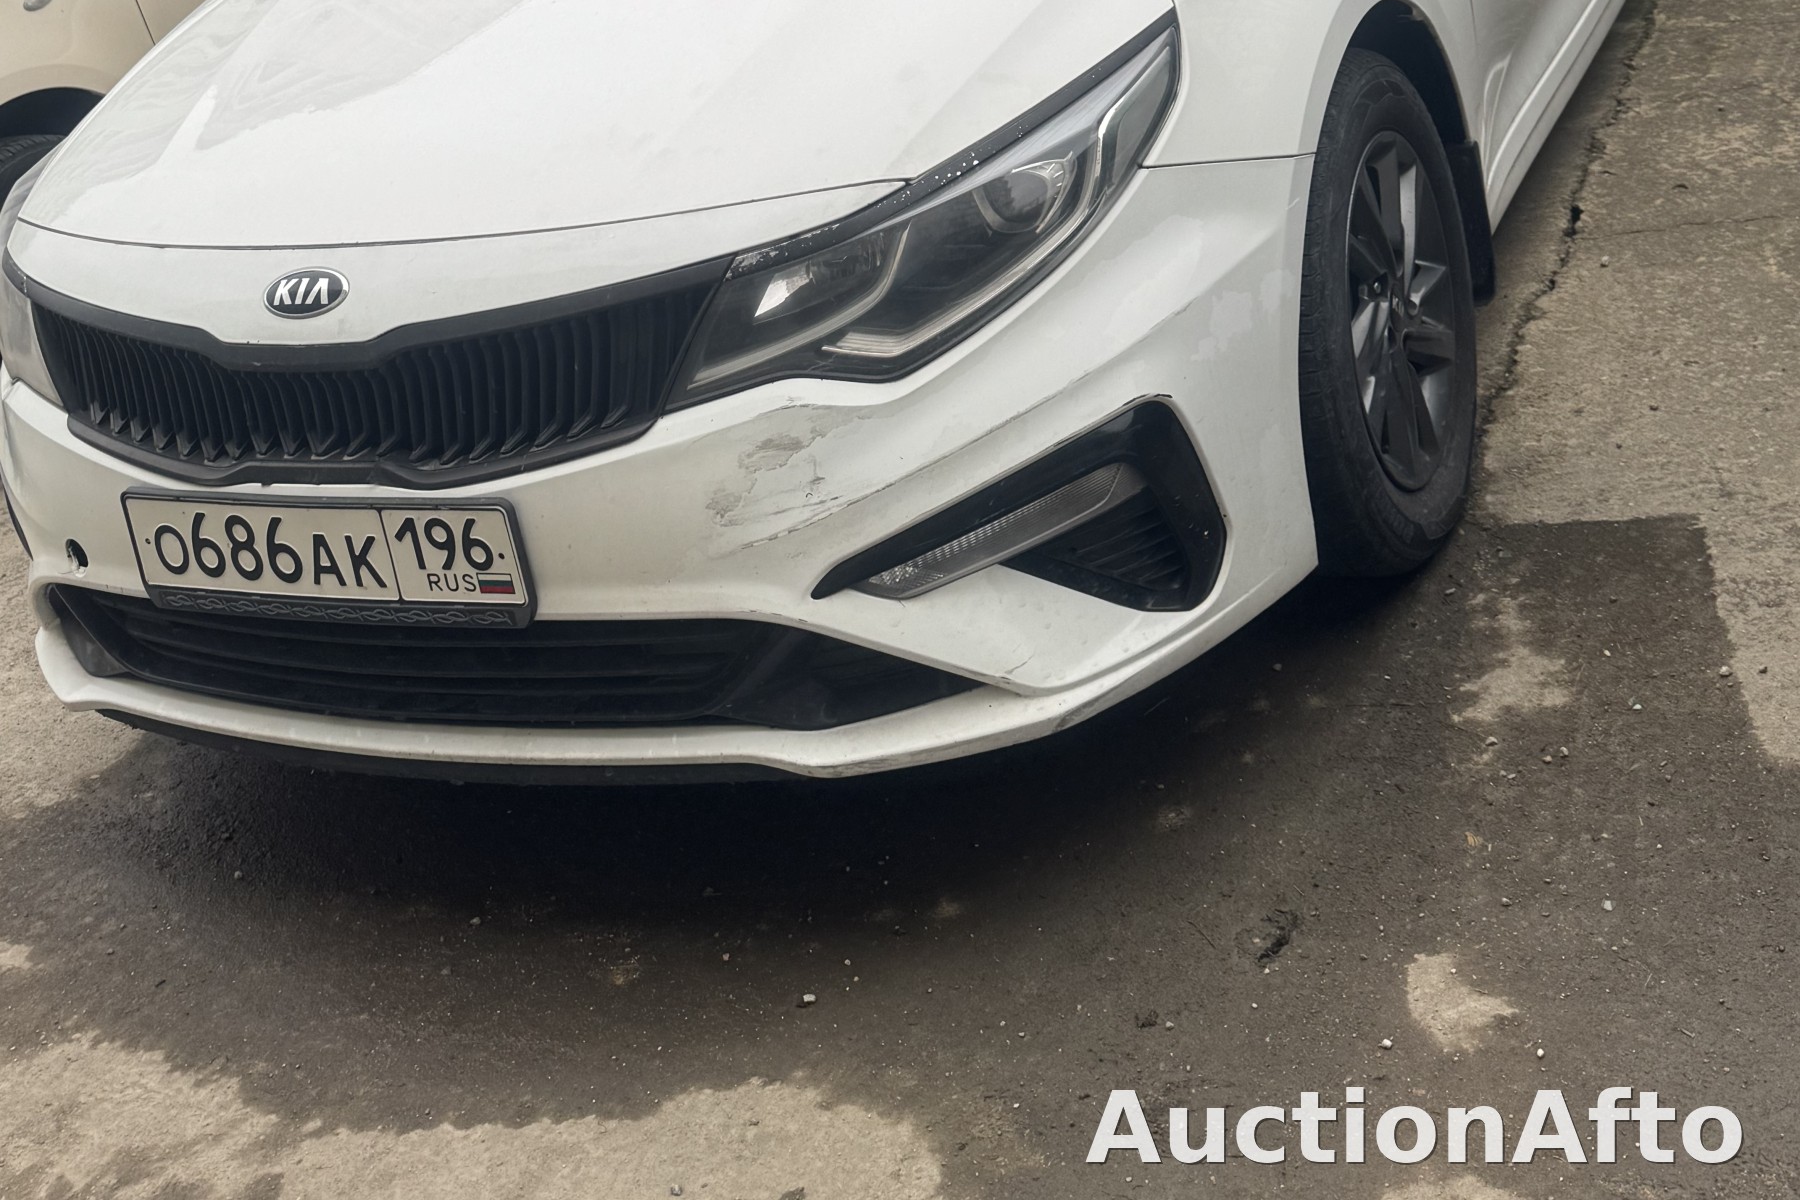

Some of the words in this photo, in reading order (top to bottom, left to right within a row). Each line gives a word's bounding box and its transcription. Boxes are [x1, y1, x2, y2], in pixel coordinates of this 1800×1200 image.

[273, 277, 329, 306] KIA
[394, 517, 494, 571] 196
[429, 573, 476, 592] RUS
